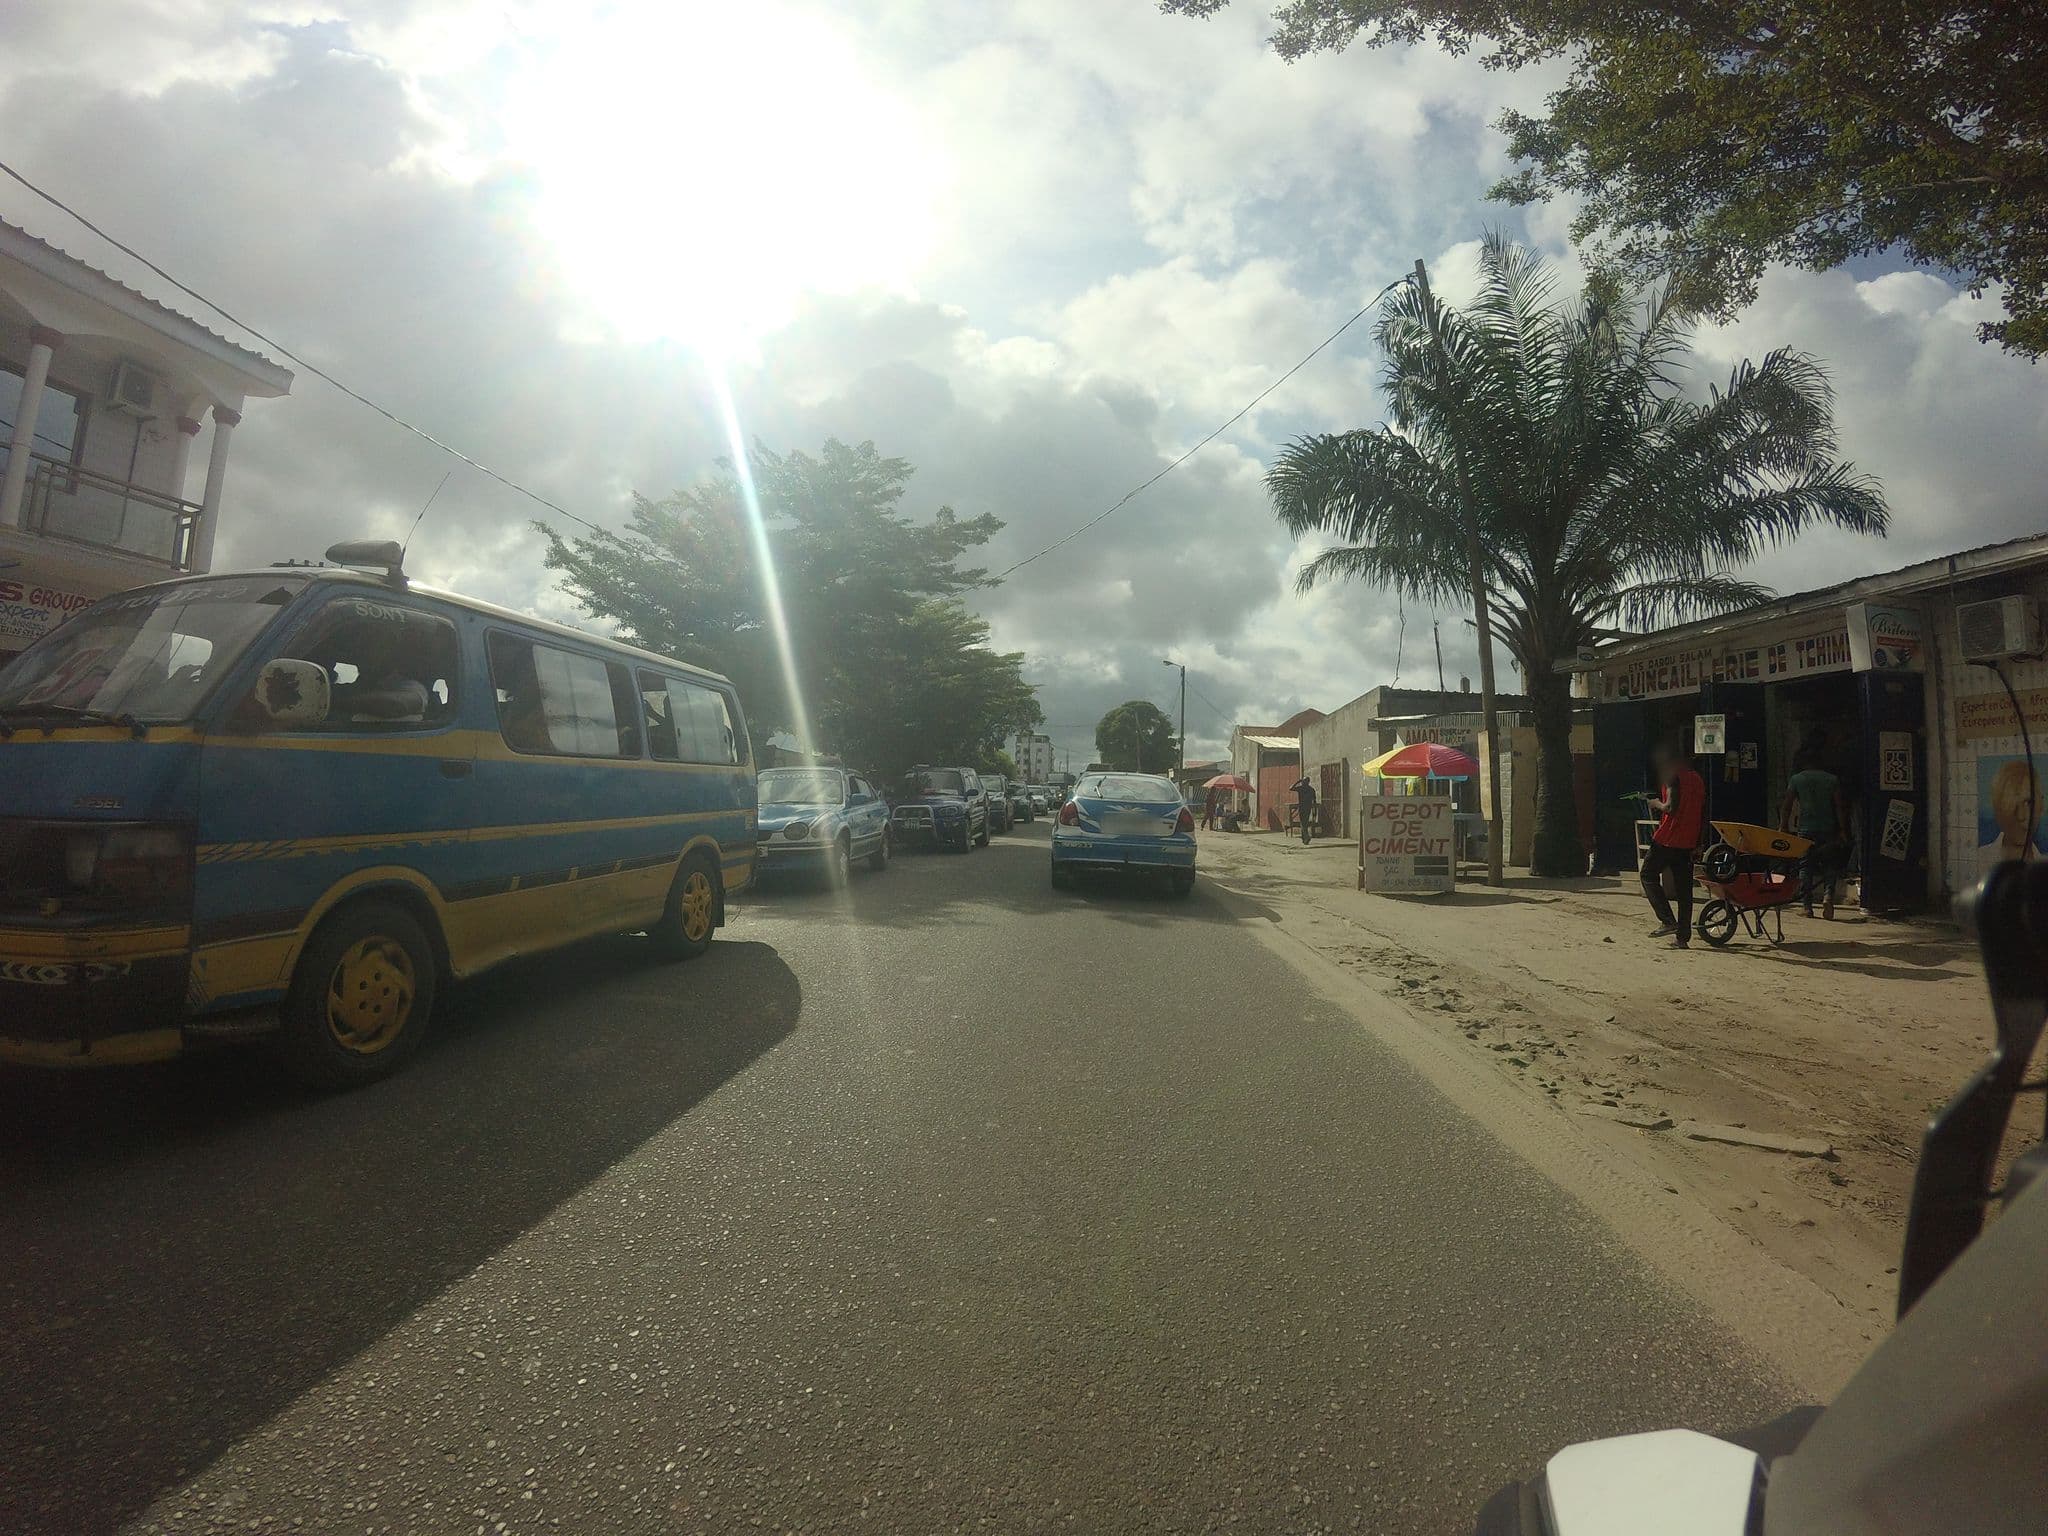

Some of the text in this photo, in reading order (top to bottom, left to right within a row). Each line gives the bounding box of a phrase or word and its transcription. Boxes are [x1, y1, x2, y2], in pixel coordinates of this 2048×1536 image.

[1617, 632, 1851, 697] QUINCAILLERIE DE TCHIM
[1628, 662, 1644, 672] ETS
[1679, 648, 1712, 662] SALAM
[1405, 728, 1440, 745] AMADI
[1370, 803, 1448, 819] DEPOT
[1391, 821, 1424, 837] DE
[1365, 838, 1450, 855] CIMENT
